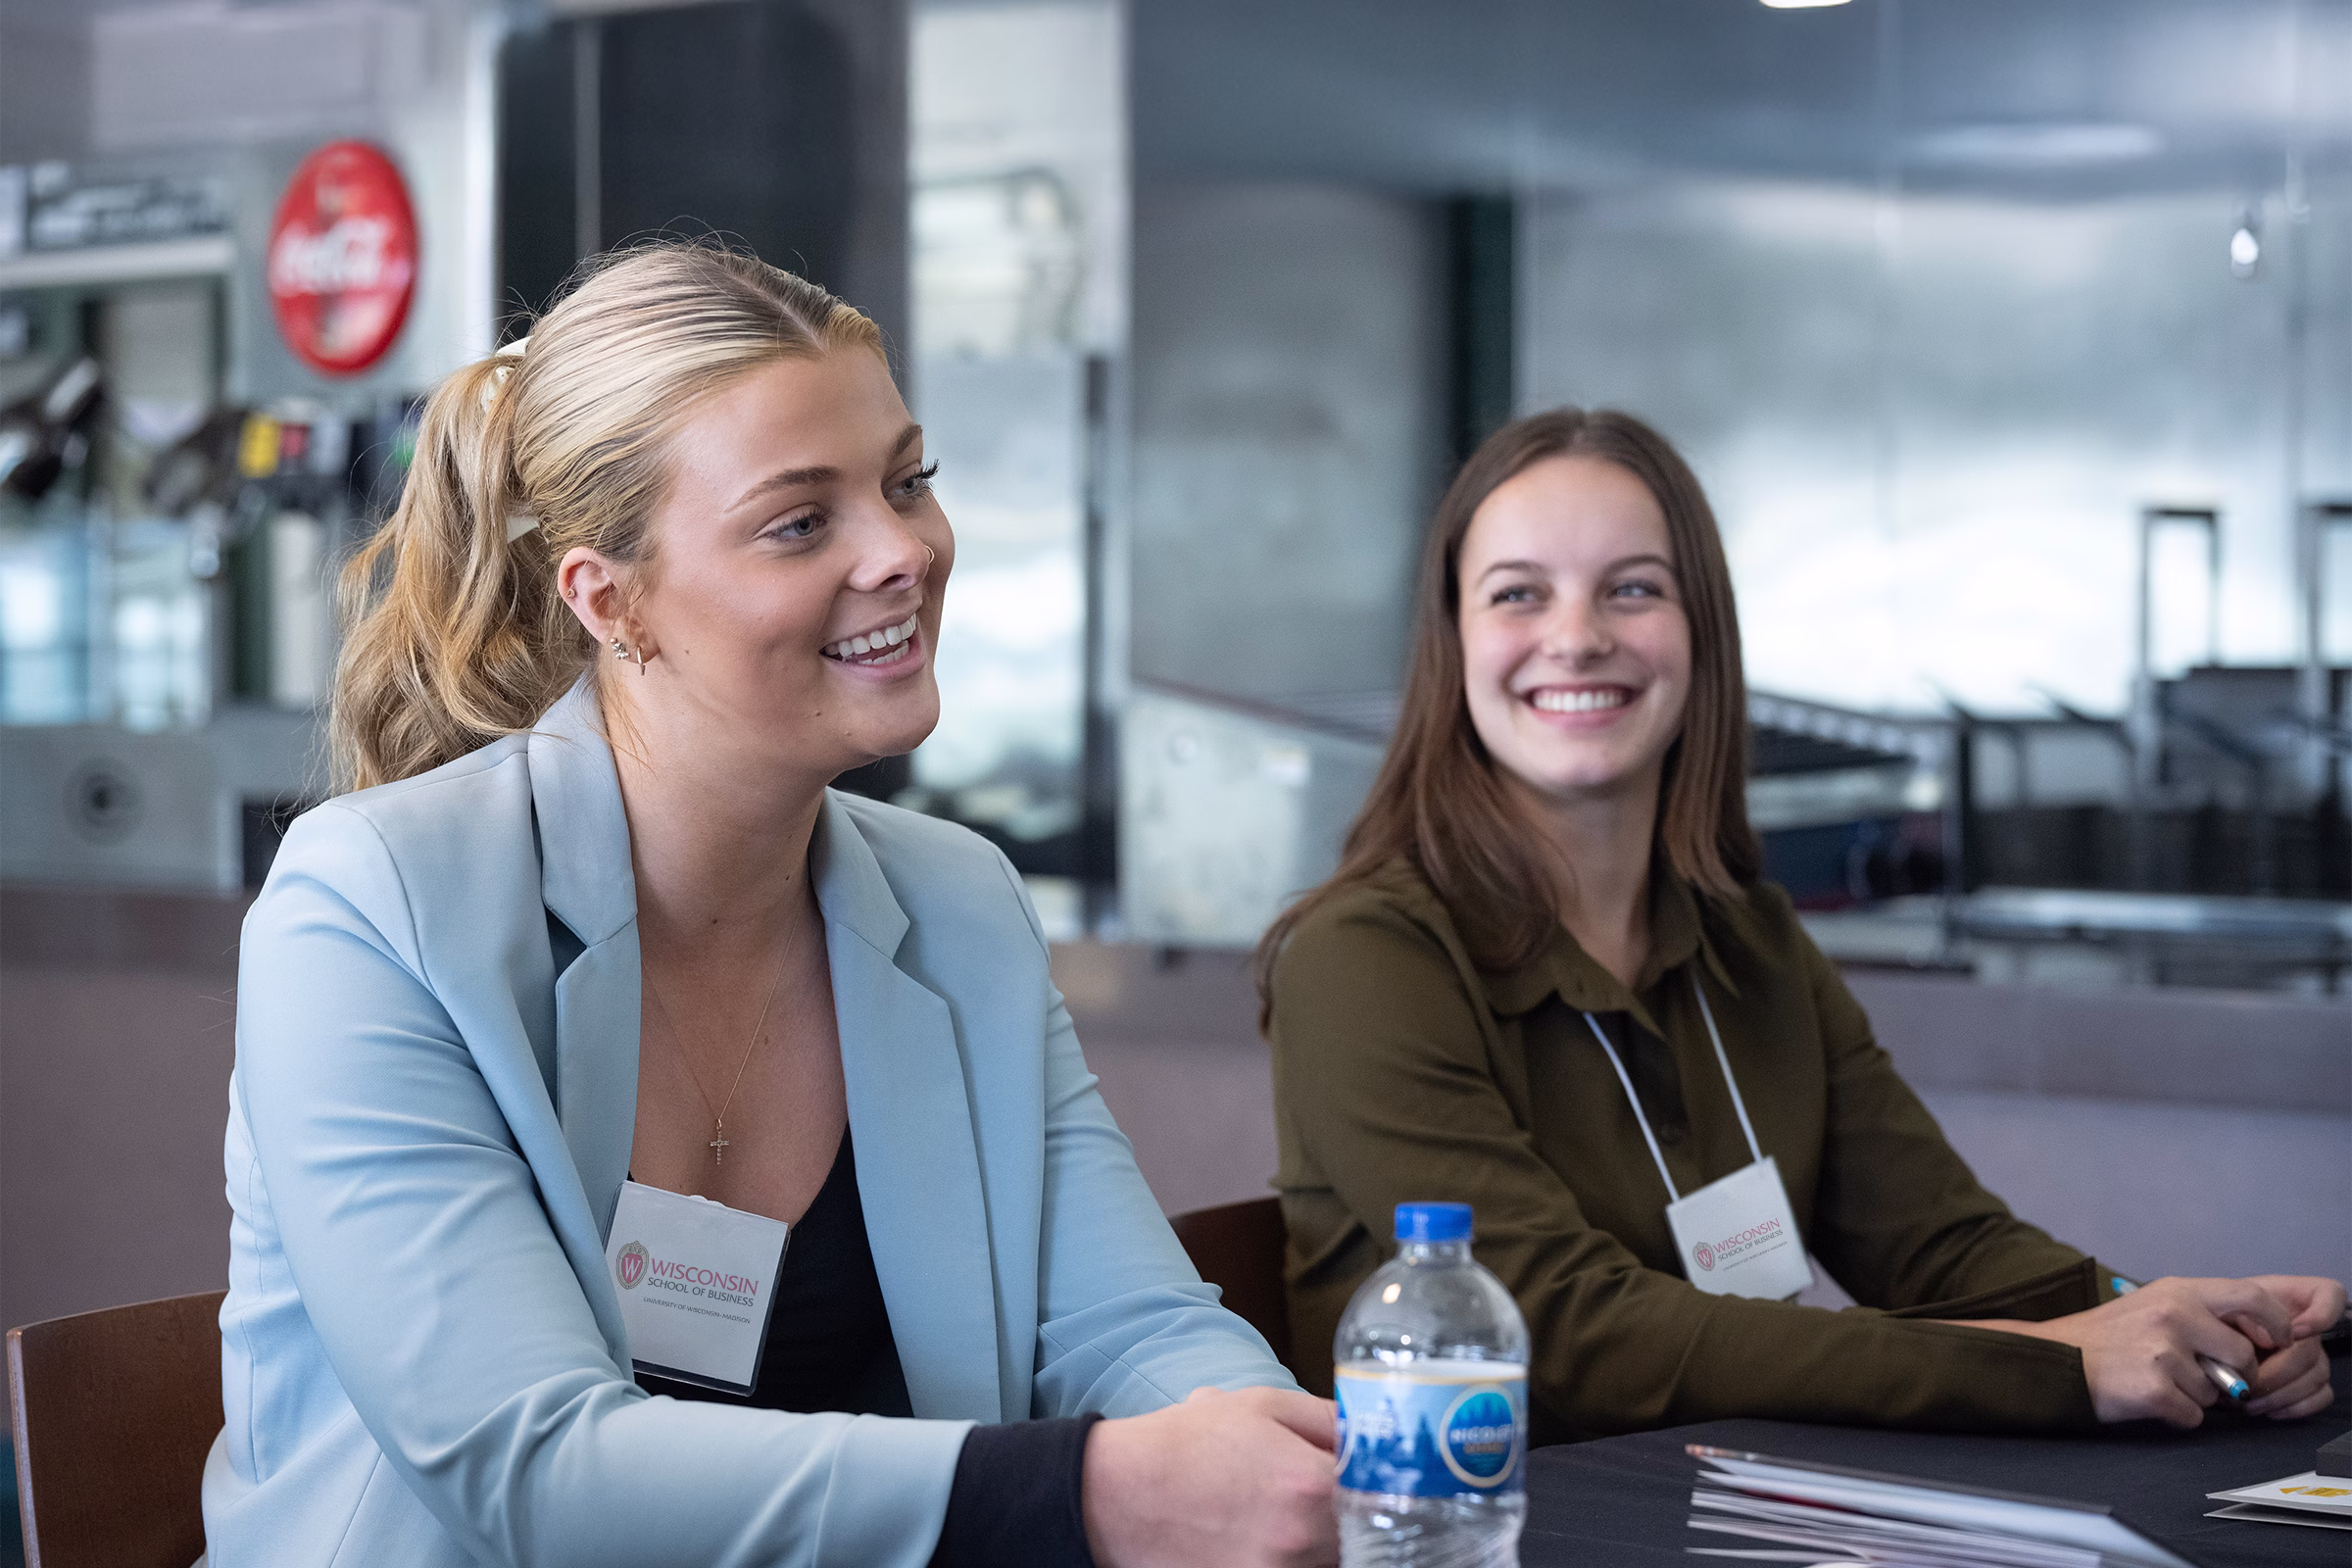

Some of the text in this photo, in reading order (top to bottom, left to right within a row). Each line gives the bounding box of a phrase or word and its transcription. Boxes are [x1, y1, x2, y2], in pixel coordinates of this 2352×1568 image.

[1713, 1217, 1781, 1253] WISCONSIN
[1718, 1247, 1744, 1261] SCHOOL
[1754, 1229, 1783, 1246] BUSINESS
[648, 1277, 754, 1307] SCHOOL OF BUSINESS
[651, 1257, 760, 1297] WISCONSIN
[643, 1297, 677, 1308] UNIVERSITY
